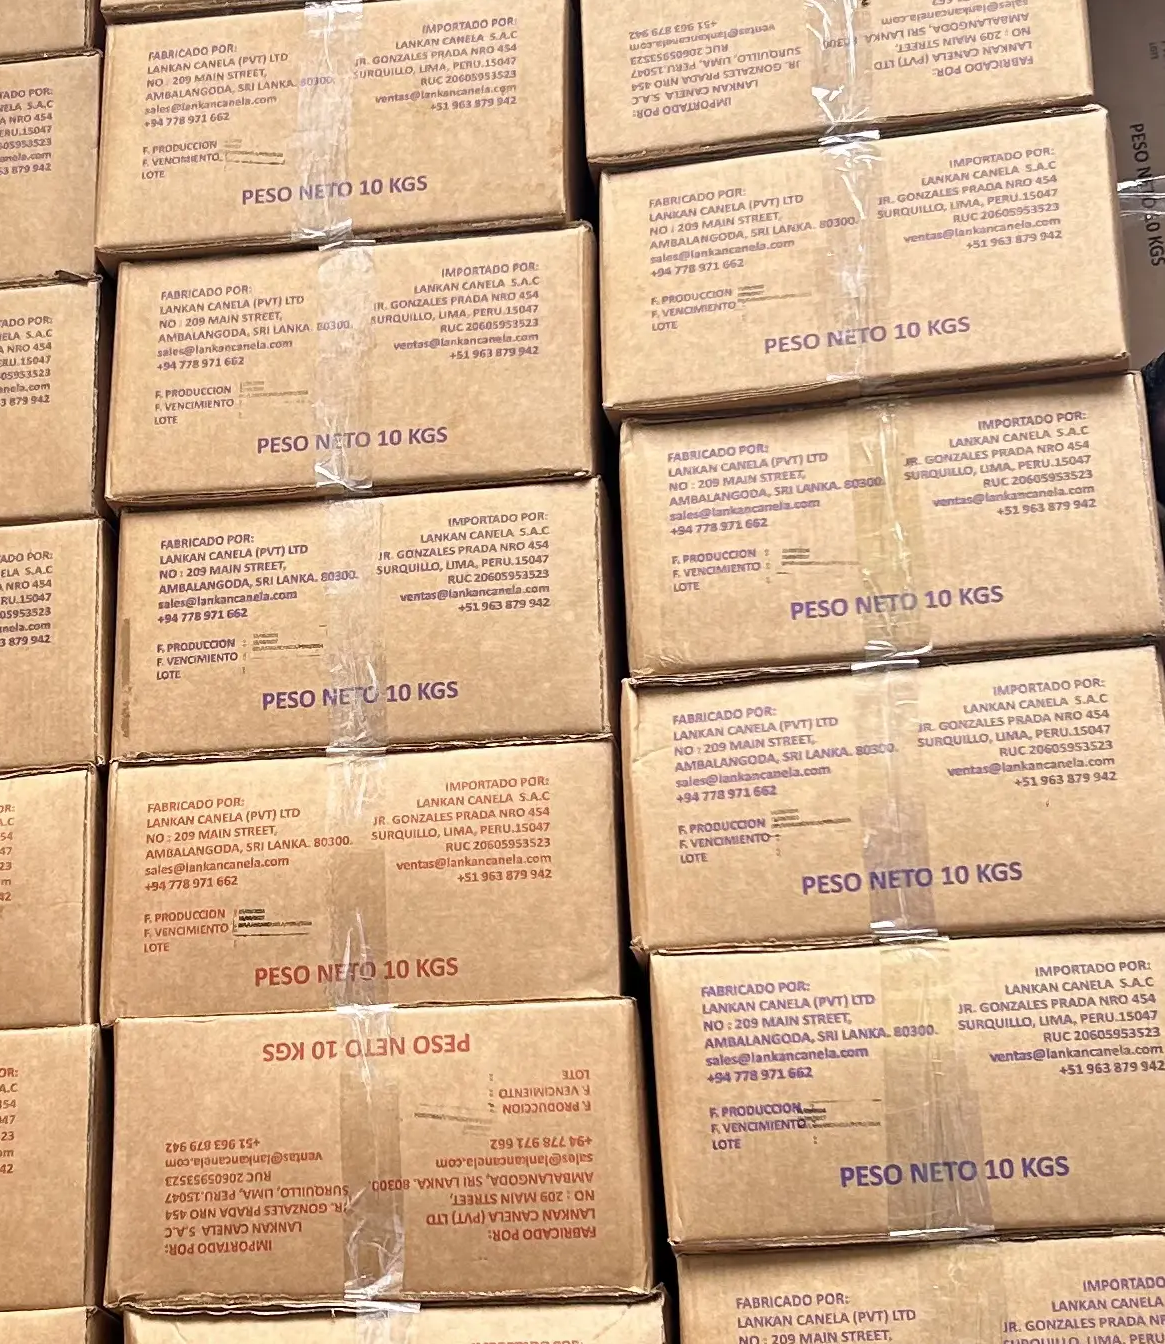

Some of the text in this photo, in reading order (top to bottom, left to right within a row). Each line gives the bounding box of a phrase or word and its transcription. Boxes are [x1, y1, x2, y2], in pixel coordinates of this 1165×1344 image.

[242, 174, 428, 206] PESO NETO 10 KGS
[1130, 123, 1165, 267] PESO KGS
[764, 315, 971, 355] PESO NETO 10 KGS
[801, 860, 1023, 896] PESO NETO 10 KGS
[254, 956, 459, 989] PESO NETO 10 KGS
[735, 1291, 851, 1310] FABRICADO POR:
[737, 1308, 917, 1329] LANKAN CANELA (PVT) LTD
